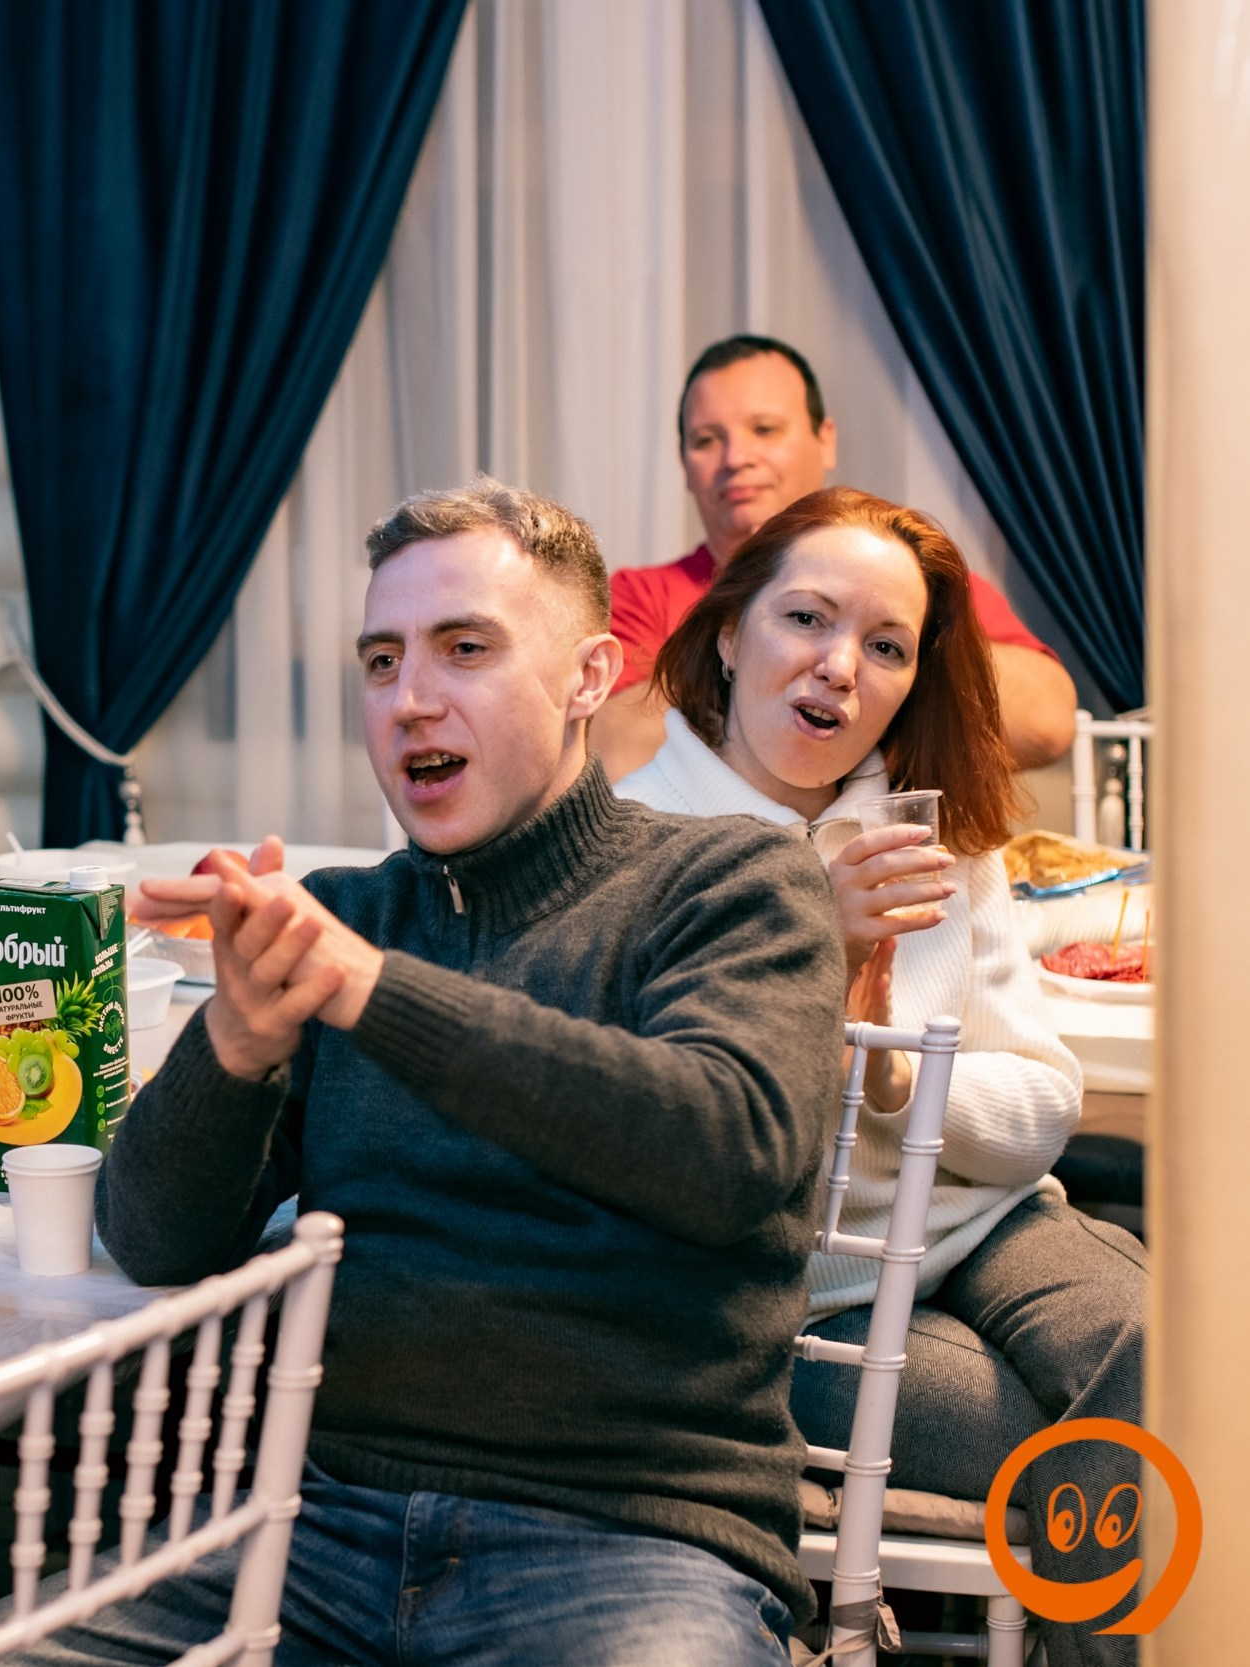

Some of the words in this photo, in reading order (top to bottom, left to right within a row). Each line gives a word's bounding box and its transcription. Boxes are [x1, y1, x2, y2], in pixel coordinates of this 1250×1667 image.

[94, 943, 119, 965] БОЛЬШЕ
[91, 958, 114, 977] ПОЛЬЗЫ
[5, 1011, 35, 1021] ФРУКТЫ
